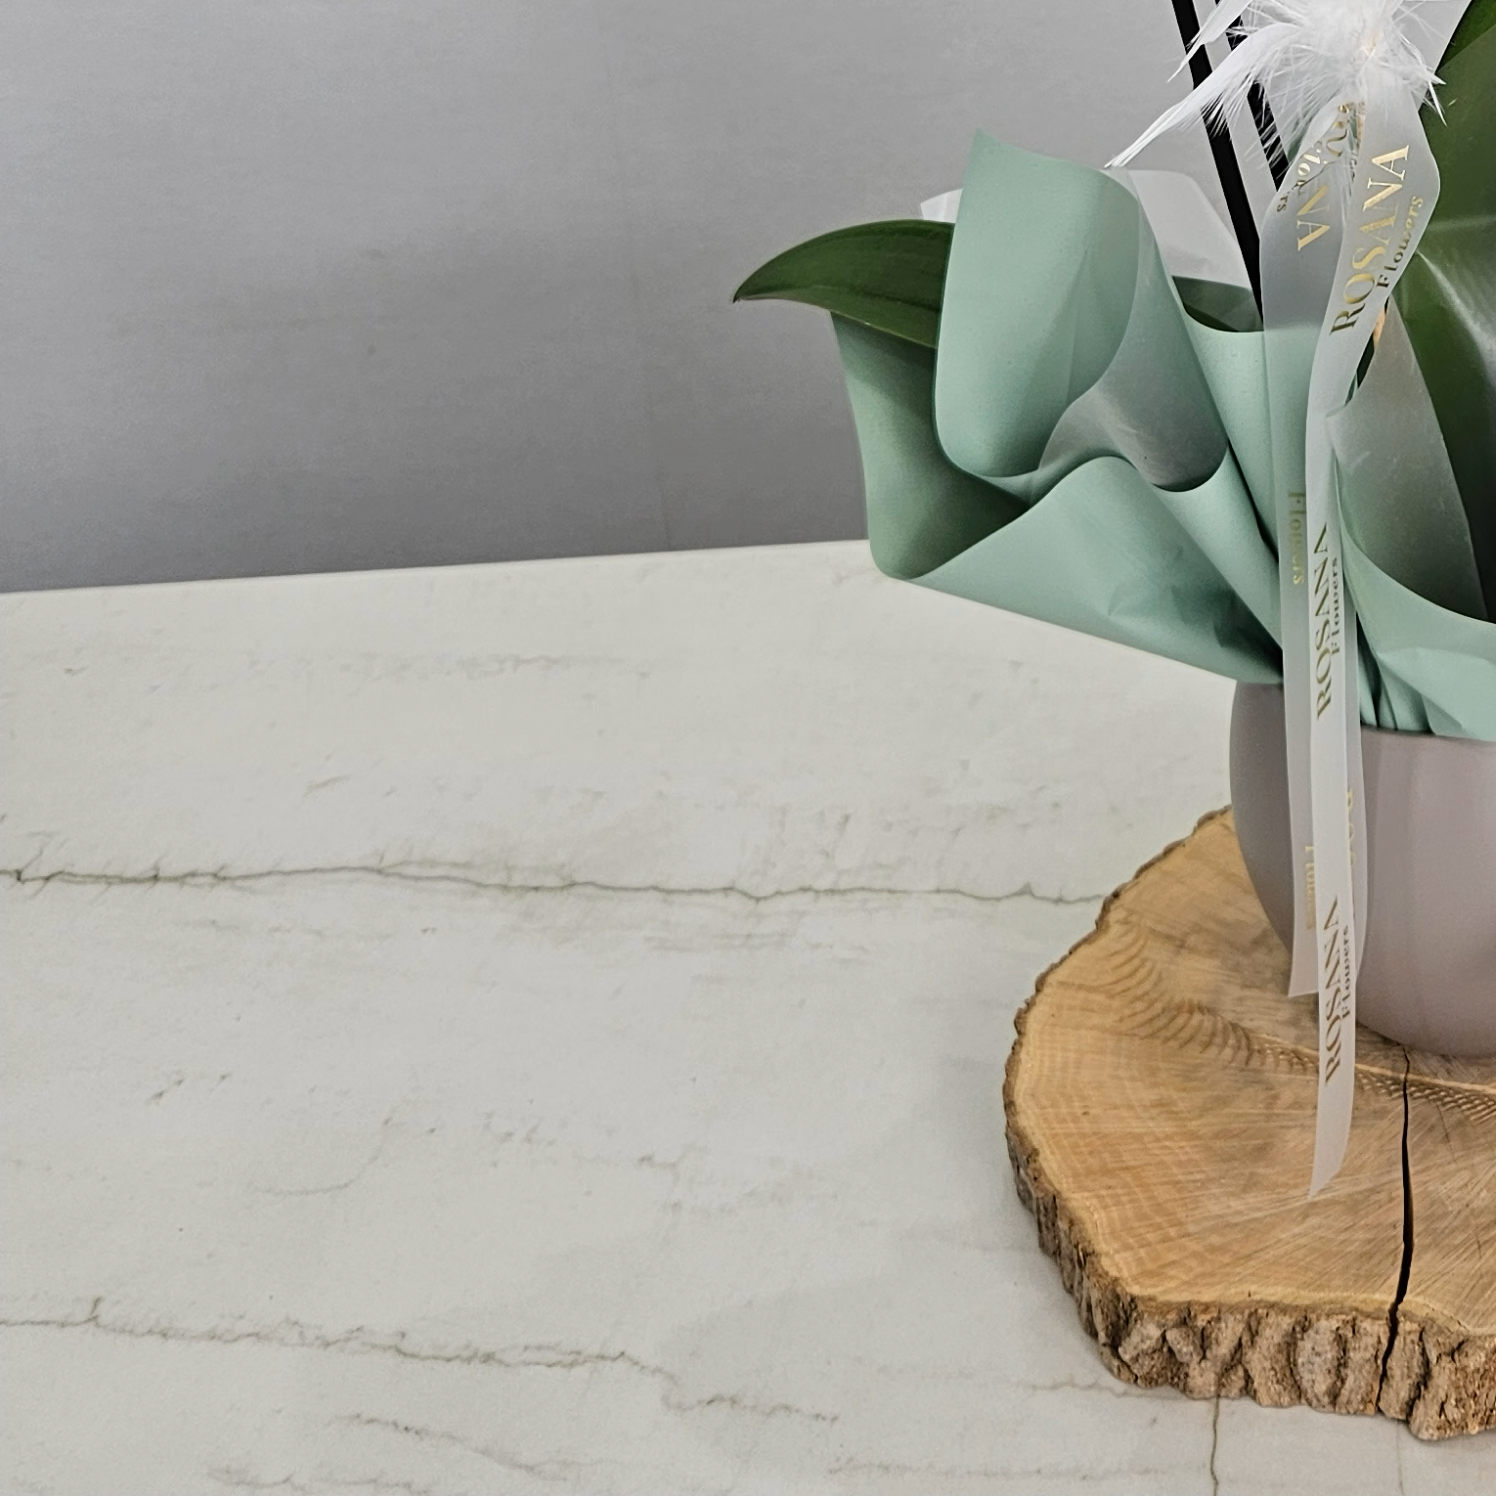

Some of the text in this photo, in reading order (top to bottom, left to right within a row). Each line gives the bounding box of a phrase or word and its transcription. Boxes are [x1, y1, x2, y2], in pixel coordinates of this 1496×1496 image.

[1330, 144, 1410, 337] ROSANA
[1376, 195, 1425, 289] Flowers
[1313, 521, 1332, 721] ROSANA
[1323, 893, 1342, 1086] ROSANA
